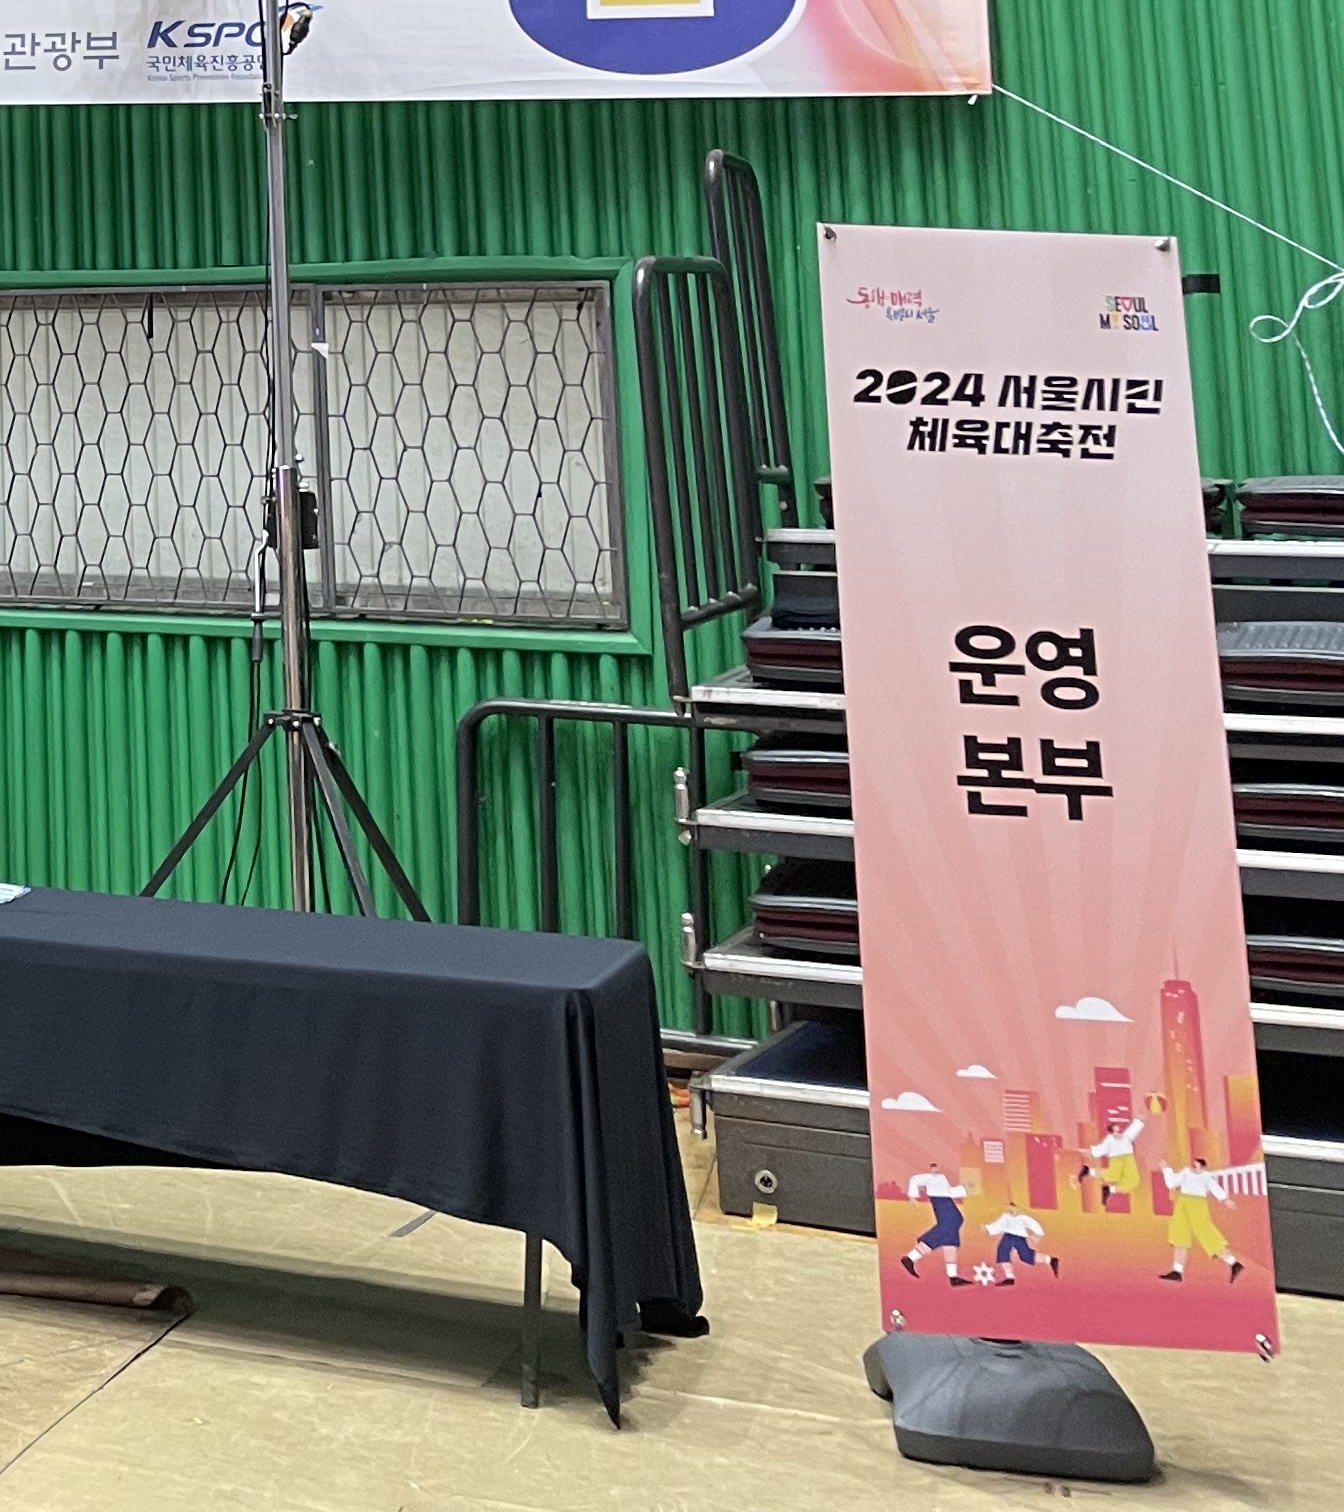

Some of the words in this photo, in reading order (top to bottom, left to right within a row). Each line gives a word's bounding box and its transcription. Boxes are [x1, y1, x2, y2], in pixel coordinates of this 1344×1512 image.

[854, 368, 986, 408] 2024
[997, 372, 1165, 416] 서울시민
[906, 416, 1118, 461] 체육대축전
[948, 624, 1100, 711] 운영
[957, 734, 1114, 821] 본부
